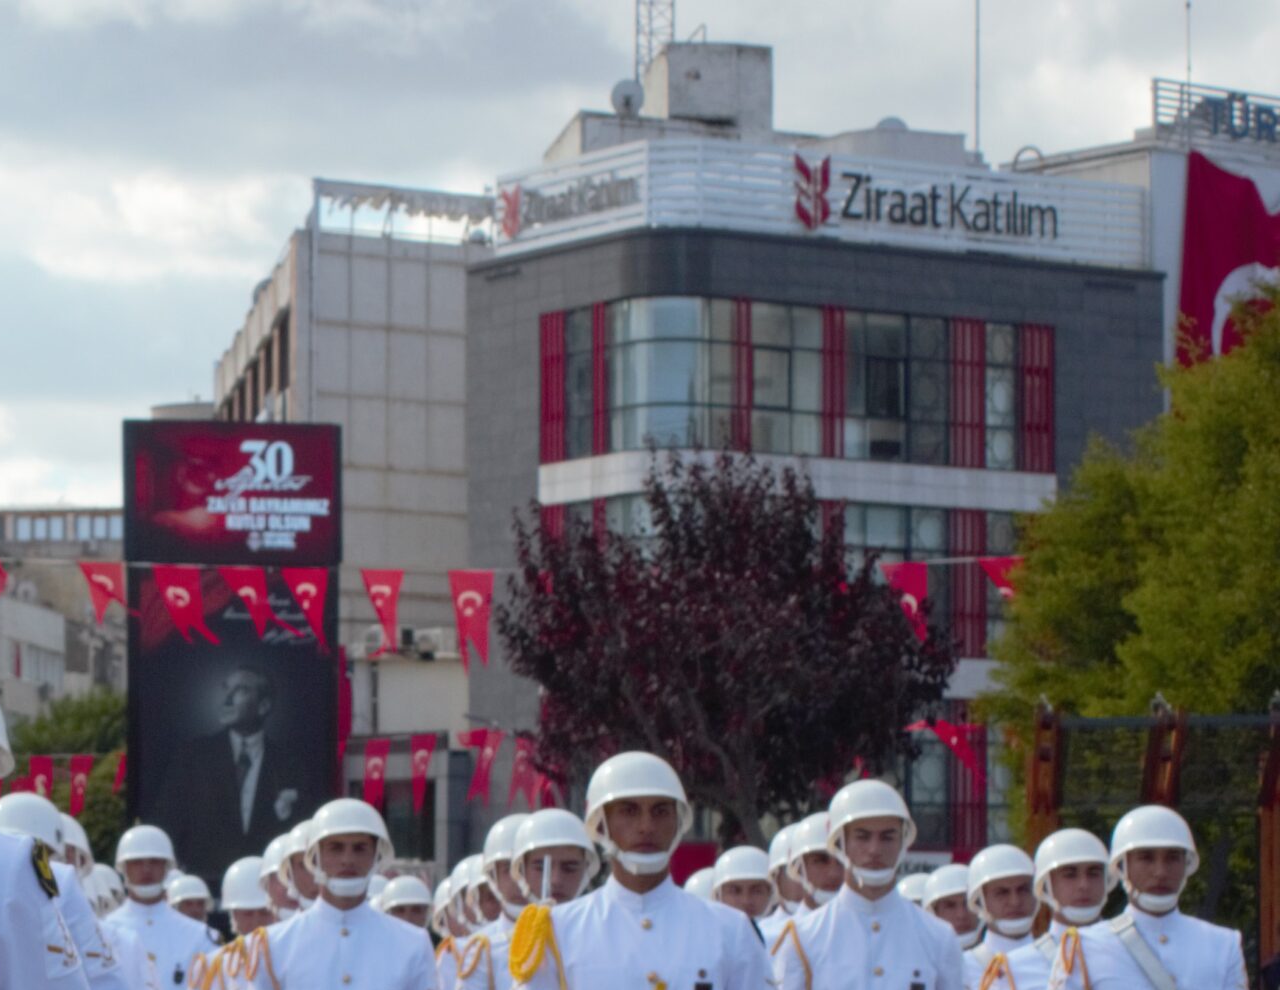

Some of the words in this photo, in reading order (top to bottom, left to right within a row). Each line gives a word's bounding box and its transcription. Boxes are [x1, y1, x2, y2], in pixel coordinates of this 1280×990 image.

[841, 172, 942, 229] Ziraat
[950, 182, 1059, 240] Katılım
[240, 440, 295, 484] 30
